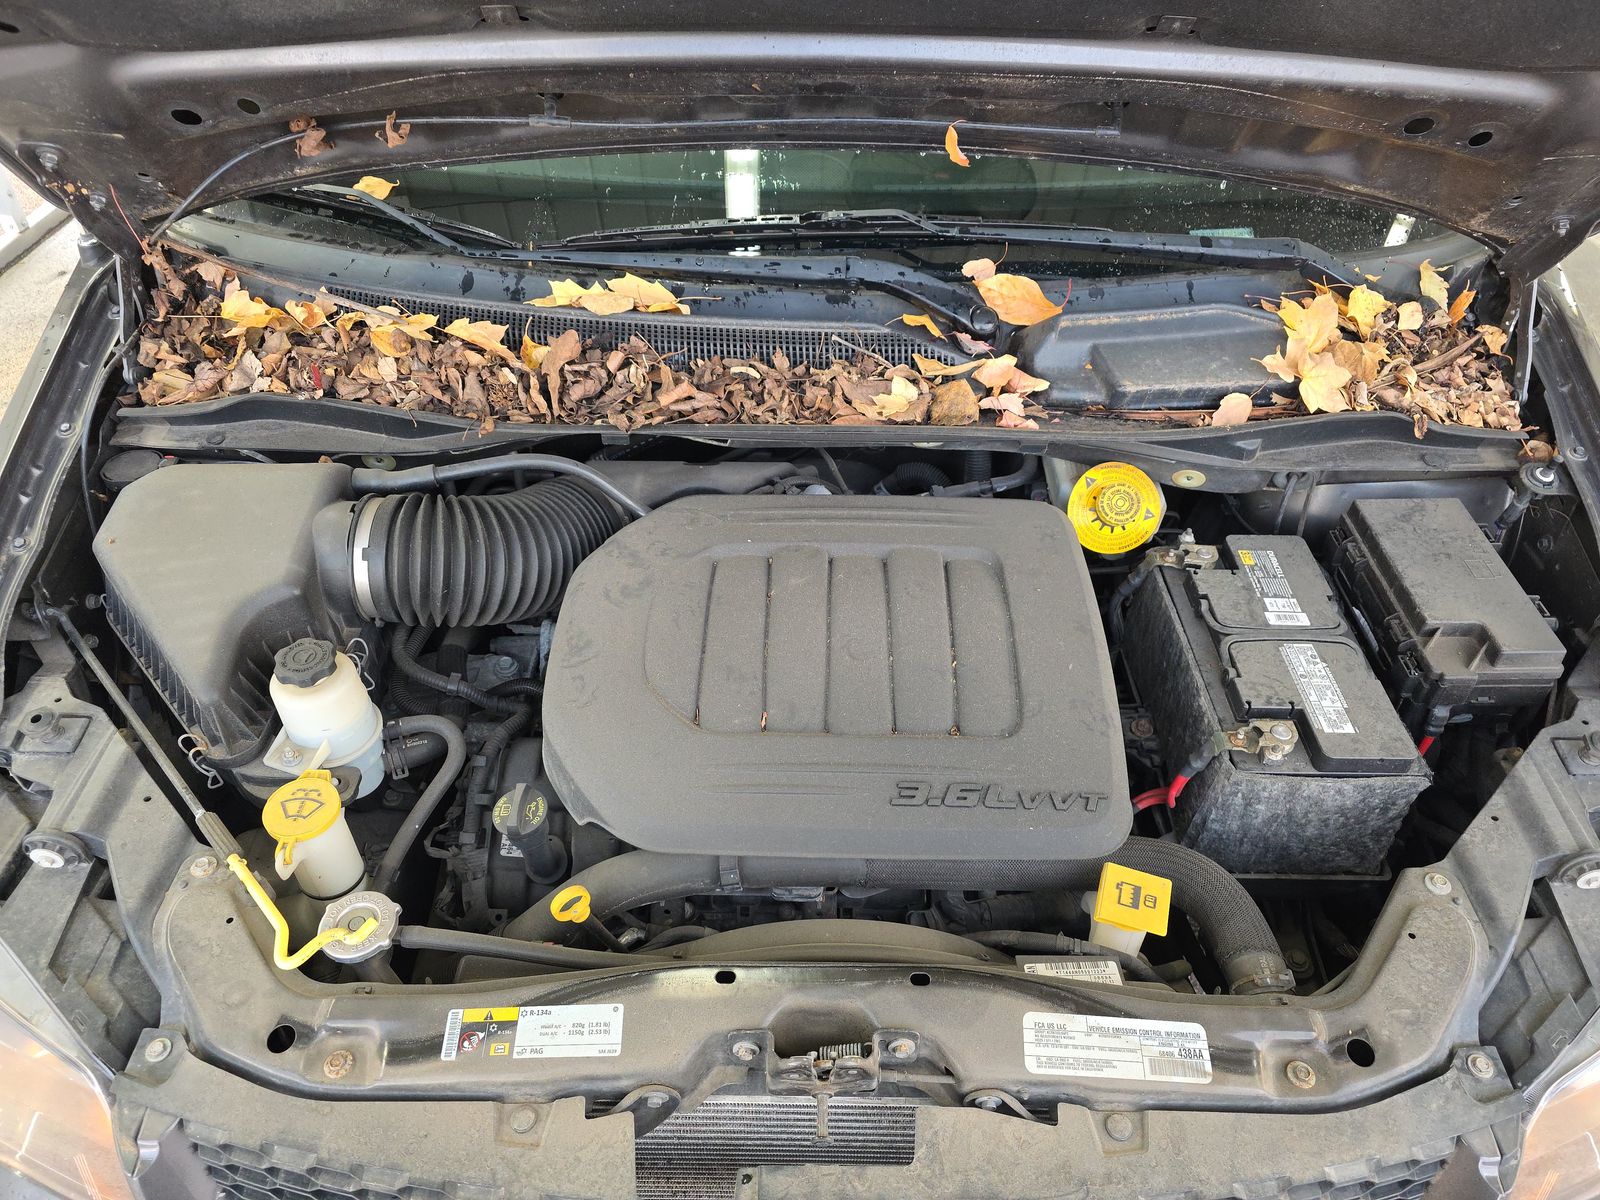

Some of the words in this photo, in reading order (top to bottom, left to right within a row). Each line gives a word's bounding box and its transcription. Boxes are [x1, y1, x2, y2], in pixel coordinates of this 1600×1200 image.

[1266, 550, 1284, 579] DURACELL
[536, 797, 544, 816] ENGINE
[1112, 1027, 1138, 1035] EMISSION
[1164, 1030, 1200, 1038] INFORMATION
[1178, 1048, 1204, 1059] 438AA
